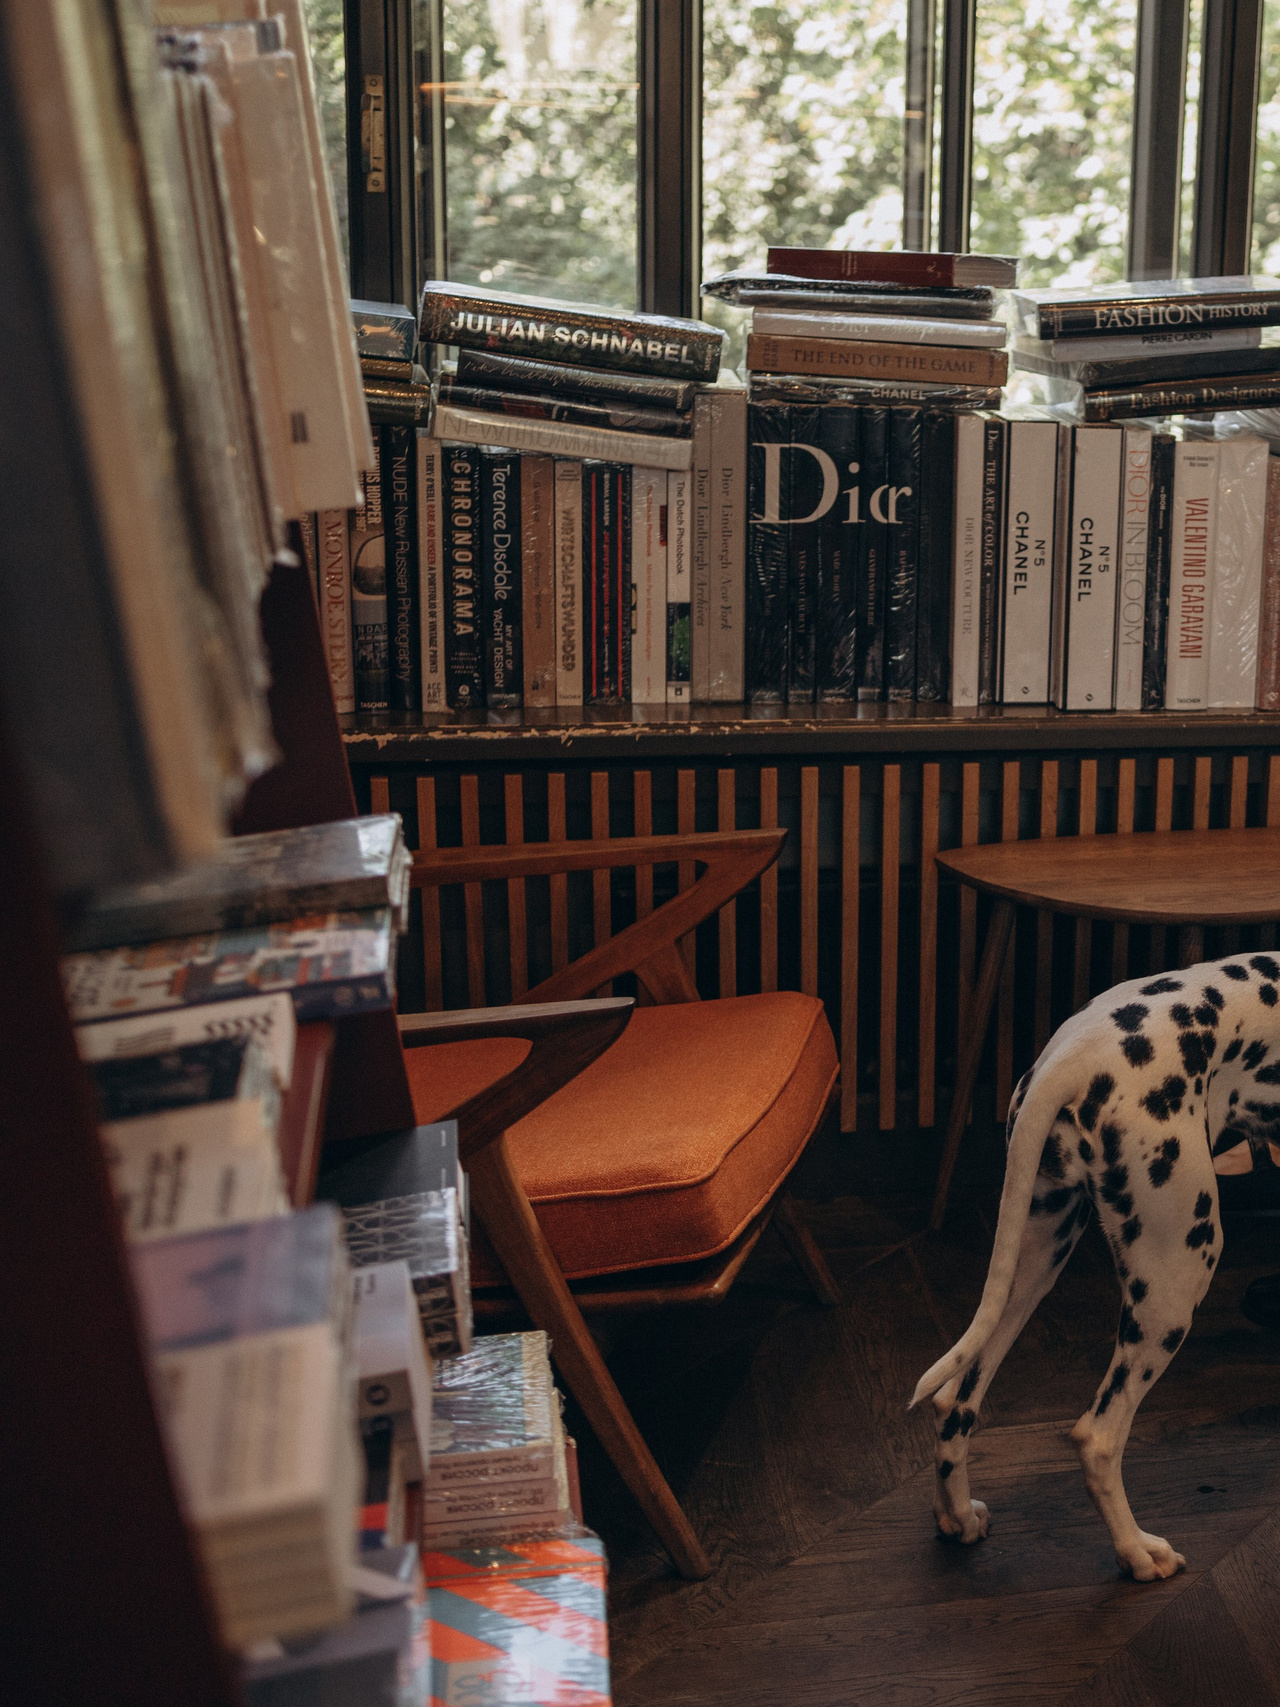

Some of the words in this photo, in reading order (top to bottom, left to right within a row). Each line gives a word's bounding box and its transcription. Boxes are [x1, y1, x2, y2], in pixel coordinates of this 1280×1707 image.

[1093, 304, 1205, 330] FASHION
[1209, 303, 1269, 320] HISTORY
[450, 312, 546, 341] JULIAN
[554, 326, 694, 364] SCHNABEL
[1141, 333, 1173, 345] PIERRE
[1173, 331, 1213, 343] CARDIN
[792, 348, 826, 364] THE
[829, 351, 866, 366] END
[868, 353, 889, 367] OF
[895, 355, 927, 369] THE
[931, 357, 976, 373] GAME
[871, 387, 927, 400] CHANEL
[1130, 392, 1196, 409] Fashion
[987, 430, 1000, 453] Dior
[391, 457, 408, 502] NUDE
[425, 455, 435, 476] TERRY
[985, 460, 997, 485] THE
[425, 478, 435, 503] O'NEILL
[676, 482, 686, 498] The
[697, 469, 709, 498] Dior
[721, 467, 734, 497] Dior
[749, 442, 913, 524] Dior
[1126, 450, 1150, 515] DIOR
[366, 486, 382, 525] HOPPER
[426, 504, 436, 522] RARE
[491, 464, 513, 532] Terence
[676, 500, 686, 525] Dutch
[984, 487, 996, 512] ART
[394, 507, 408, 537] New
[964, 516, 974, 545] DIOR
[983, 513, 996, 524] of
[1125, 522, 1147, 544] IN
[451, 461, 475, 637] CHRONORAMA
[645, 524, 654, 557] Photobook
[675, 527, 686, 575] Photobook
[694, 506, 709, 571] Lindbergh
[718, 504, 734, 570] Lindbergh
[983, 525, 995, 567] COLOR
[1182, 498, 1210, 578] VALENTINO
[325, 520, 346, 613] MONROE
[395, 541, 411, 594] Russian
[492, 533, 514, 600] Disdale
[963, 550, 974, 578] NEW
[1013, 511, 1030, 596] CHANEL
[1077, 517, 1094, 602] CHANEL
[427, 573, 438, 610] PORTFOLIO
[560, 506, 577, 672] WIRTSCHAFTSWUNDER
[1122, 553, 1146, 646] BLOOM
[428, 611, 438, 620] OF
[962, 579, 973, 635] COUTURE
[1179, 584, 1206, 659] GARAVANI
[395, 597, 413, 682] Photography
[428, 621, 438, 648] VINTAGE
[493, 608, 504, 643] YACHT
[505, 625, 513, 637] MY
[429, 650, 439, 675] PRINTS
[505, 640, 514, 656] ART
[493, 647, 505, 689] DESIGN
[505, 659, 514, 672] OF
[360, 701, 388, 709] TASCHEN
